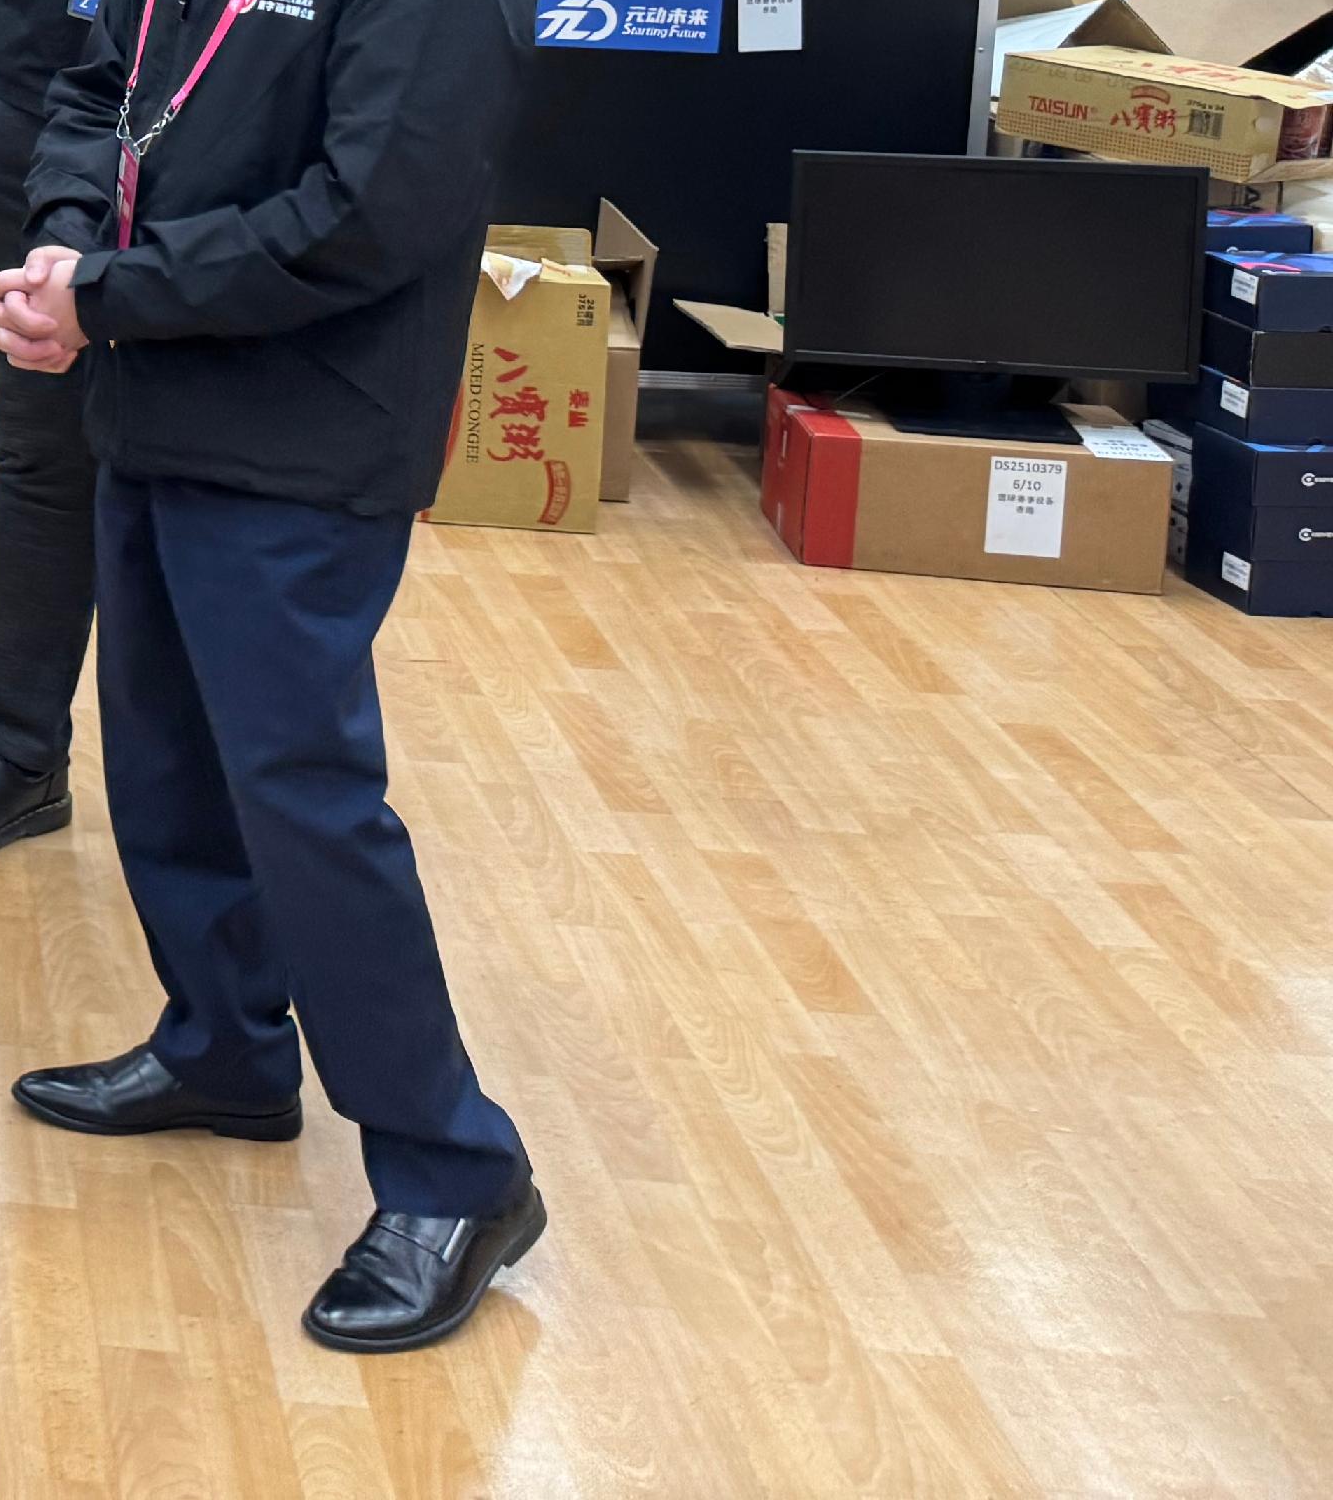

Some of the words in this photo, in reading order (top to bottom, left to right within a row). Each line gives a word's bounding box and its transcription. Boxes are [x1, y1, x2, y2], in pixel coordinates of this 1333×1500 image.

[625, 6, 709, 26] 元动未来
[622, 23, 666, 38] Starting
[668, 24, 706, 39] Future
[1028, 95, 1089, 120] TAISUN
[470, 343, 484, 395] MIXED
[487, 346, 549, 462] 八寶粥
[466, 400, 482, 464] CONGEE
[994, 460, 1062, 474] DS2510379
[1012, 479, 1042, 491] 6/10
